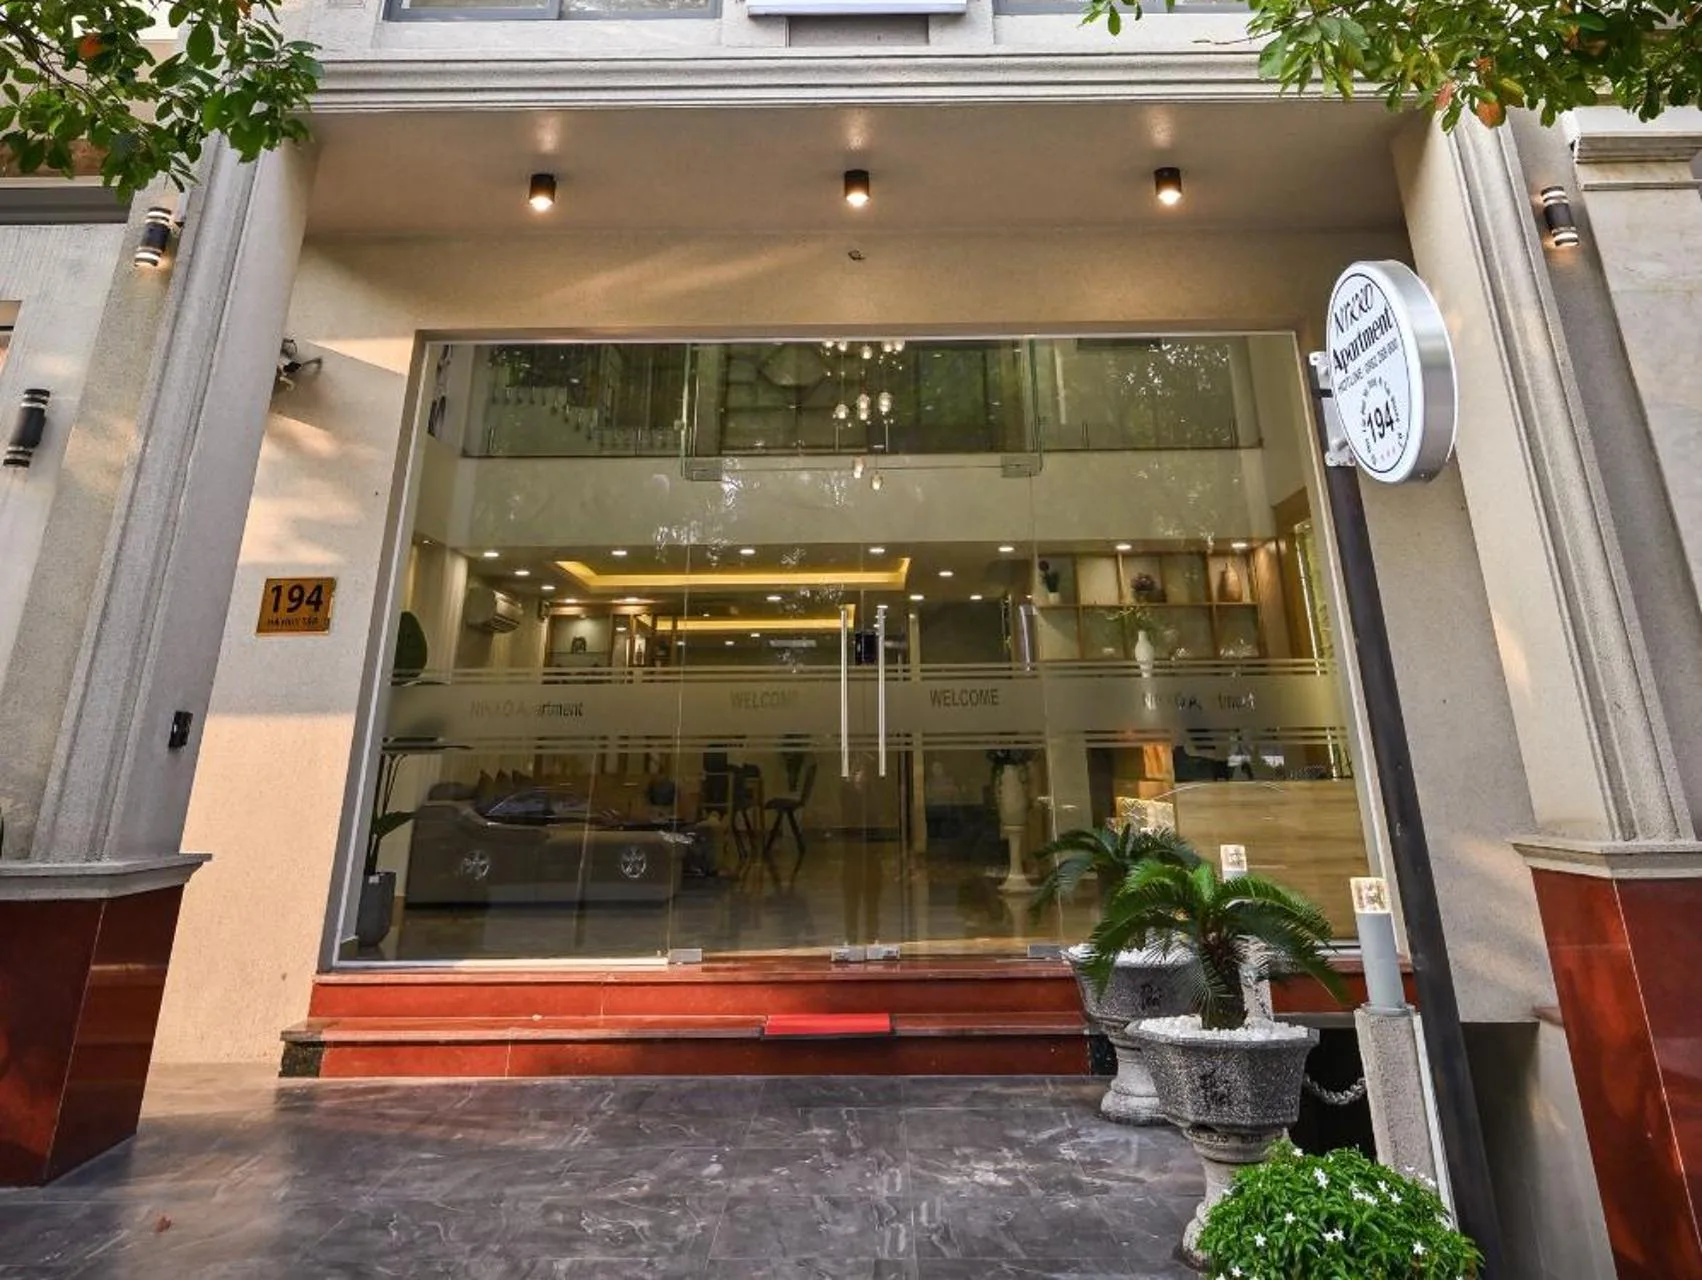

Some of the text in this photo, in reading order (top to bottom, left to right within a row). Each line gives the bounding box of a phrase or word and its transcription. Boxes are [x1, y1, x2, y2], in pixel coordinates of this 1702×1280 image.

[1332, 303, 1394, 374] Apartment
[1366, 401, 1395, 443] 194
[270, 583, 324, 614] 194
[929, 687, 1000, 709] WELCOME
